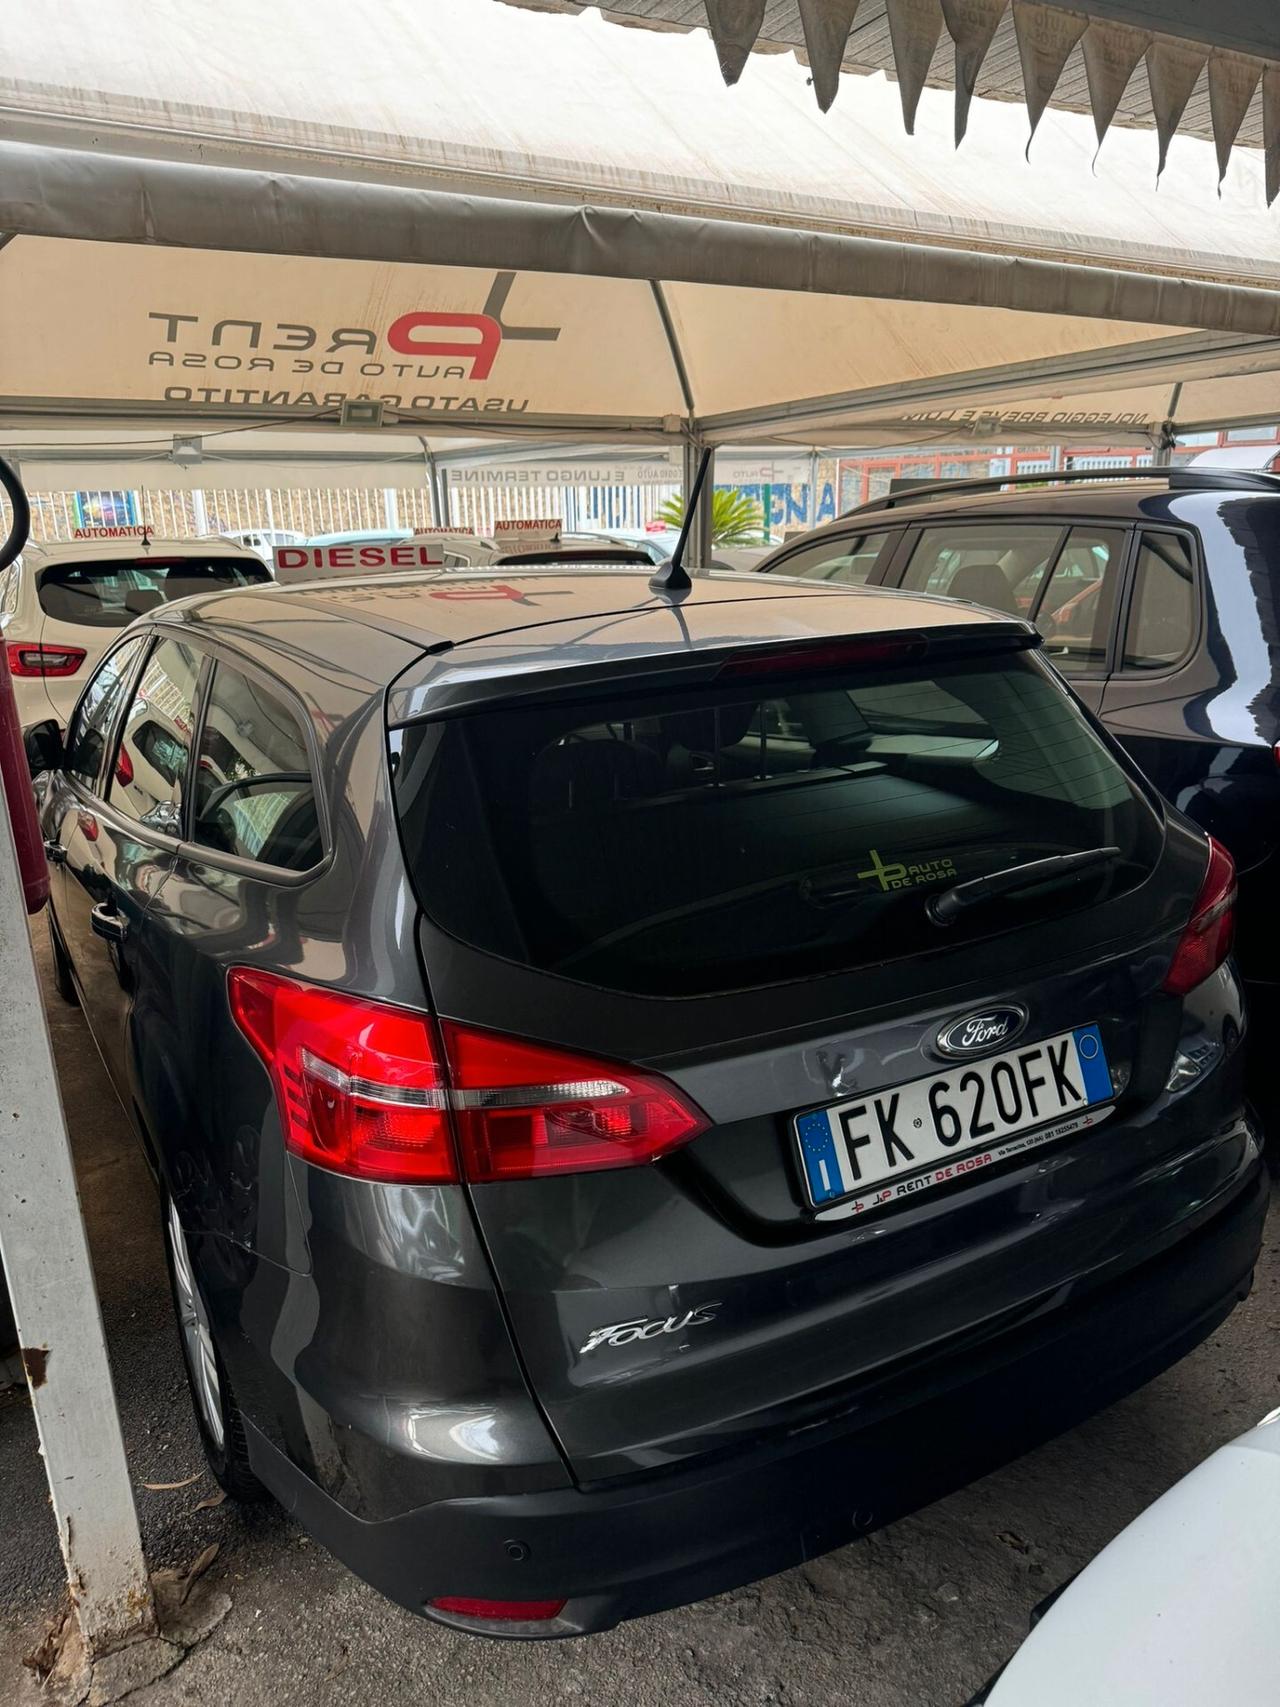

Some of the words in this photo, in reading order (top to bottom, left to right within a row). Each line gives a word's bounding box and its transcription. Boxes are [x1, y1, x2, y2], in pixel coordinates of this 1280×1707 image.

[75, 525, 154, 539] AUTOMATICA
[495, 519, 562, 531] AUTOMATICA
[277, 546, 443, 569] DIESEL
[908, 858, 953, 876] AUTO
[891, 877, 912, 889] DE
[915, 868, 958, 884] ROSA
[961, 1013, 1010, 1047] Ford
[838, 1092, 915, 1181] FK
[927, 1039, 1082, 1147] 620FK
[896, 1175, 932, 1196] RENT
[935, 1168, 953, 1182] DE
[956, 1153, 993, 1174] ROSA
